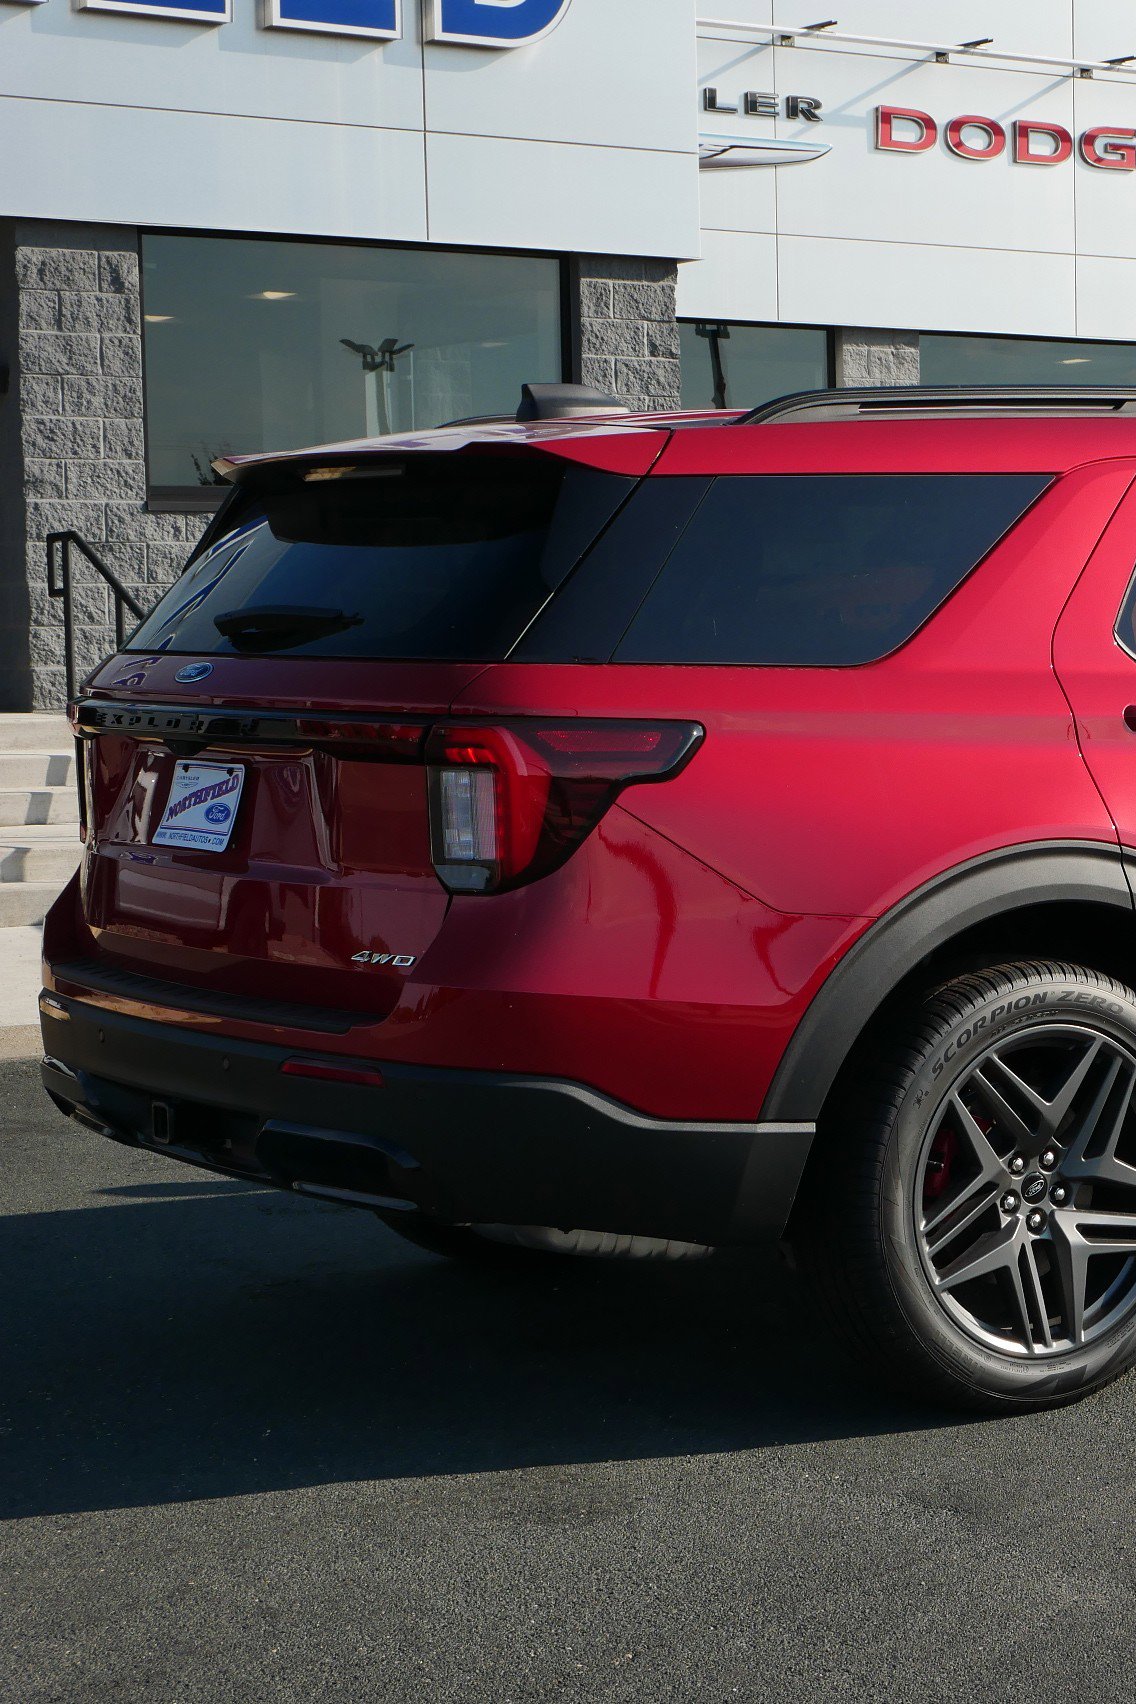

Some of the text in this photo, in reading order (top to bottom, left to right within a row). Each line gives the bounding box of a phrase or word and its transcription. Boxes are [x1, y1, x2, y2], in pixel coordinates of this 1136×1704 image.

[166, 774, 240, 822] NORTHFIELD
[351, 950, 416, 966] 4WD
[931, 989, 1124, 1079] SCORPION ZERO
